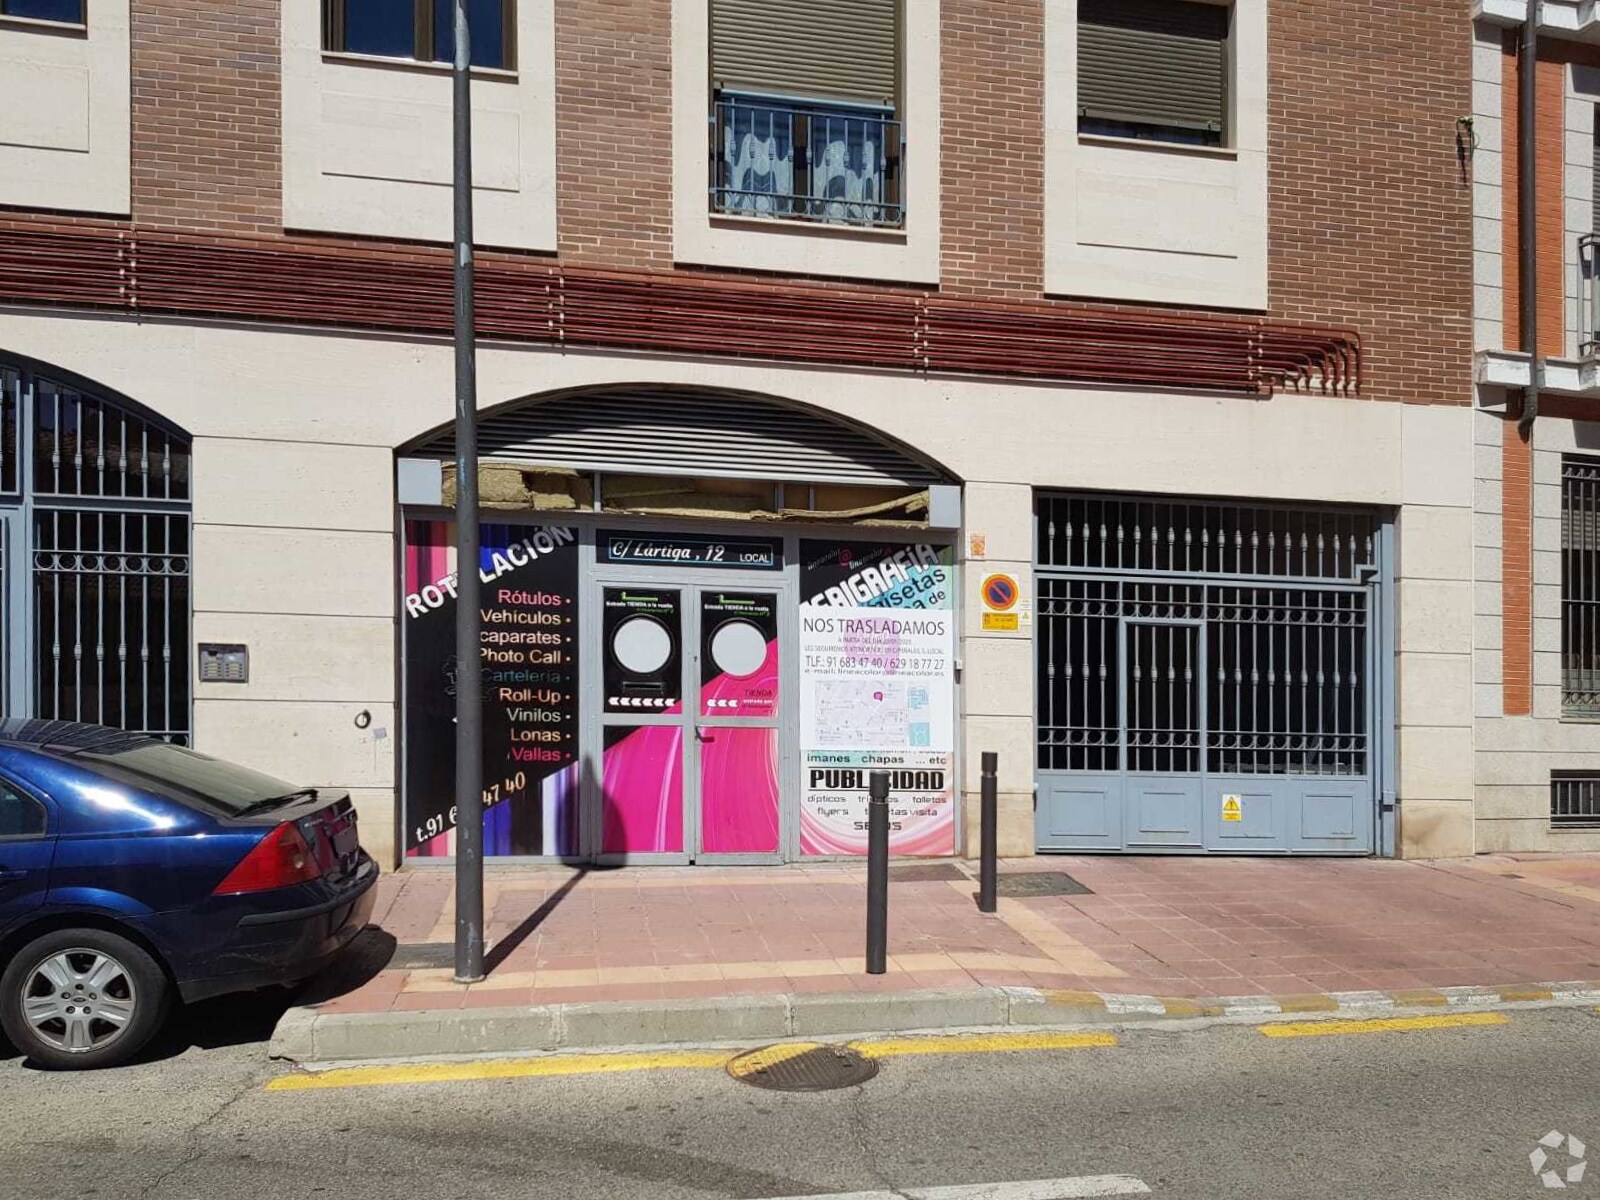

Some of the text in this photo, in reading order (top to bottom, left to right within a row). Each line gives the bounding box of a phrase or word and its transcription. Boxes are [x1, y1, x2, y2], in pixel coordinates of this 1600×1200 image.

[612, 539, 633, 559] C/
[705, 544, 725, 562] 12
[739, 553, 770, 563] LOCAL
[405, 524, 574, 618] ROTLACIÓN
[498, 589, 562, 606] Rótulos
[928, 590, 946, 605] de
[480, 608, 562, 625] Vehículos
[803, 617, 945, 636] NOS TRASLADAMOS
[480, 631, 562, 645] caparates
[529, 649, 561, 664] Call
[827, 656, 837, 668] 91
[839, 656, 856, 668] 683
[858, 657, 869, 668] 47
[871, 658, 883, 668] 40
[890, 658, 906, 669] 629
[909, 658, 919, 669] 18
[921, 659, 932, 669] 77
[934, 659, 945, 670] 27
[500, 687, 561, 705] Roll-Up
[506, 707, 561, 722] Vinilos
[510, 728, 561, 742] Lonas
[512, 747, 561, 761] Vallas
[807, 753, 850, 763] imanes
[861, 754, 905, 765] chapas
[929, 755, 947, 765] etc
[810, 769, 944, 790] PUBLIDAD
[482, 771, 526, 806] 47 40
[913, 795, 947, 804] folletos
[817, 807, 849, 817] flyers
[909, 808, 938, 817] visita
